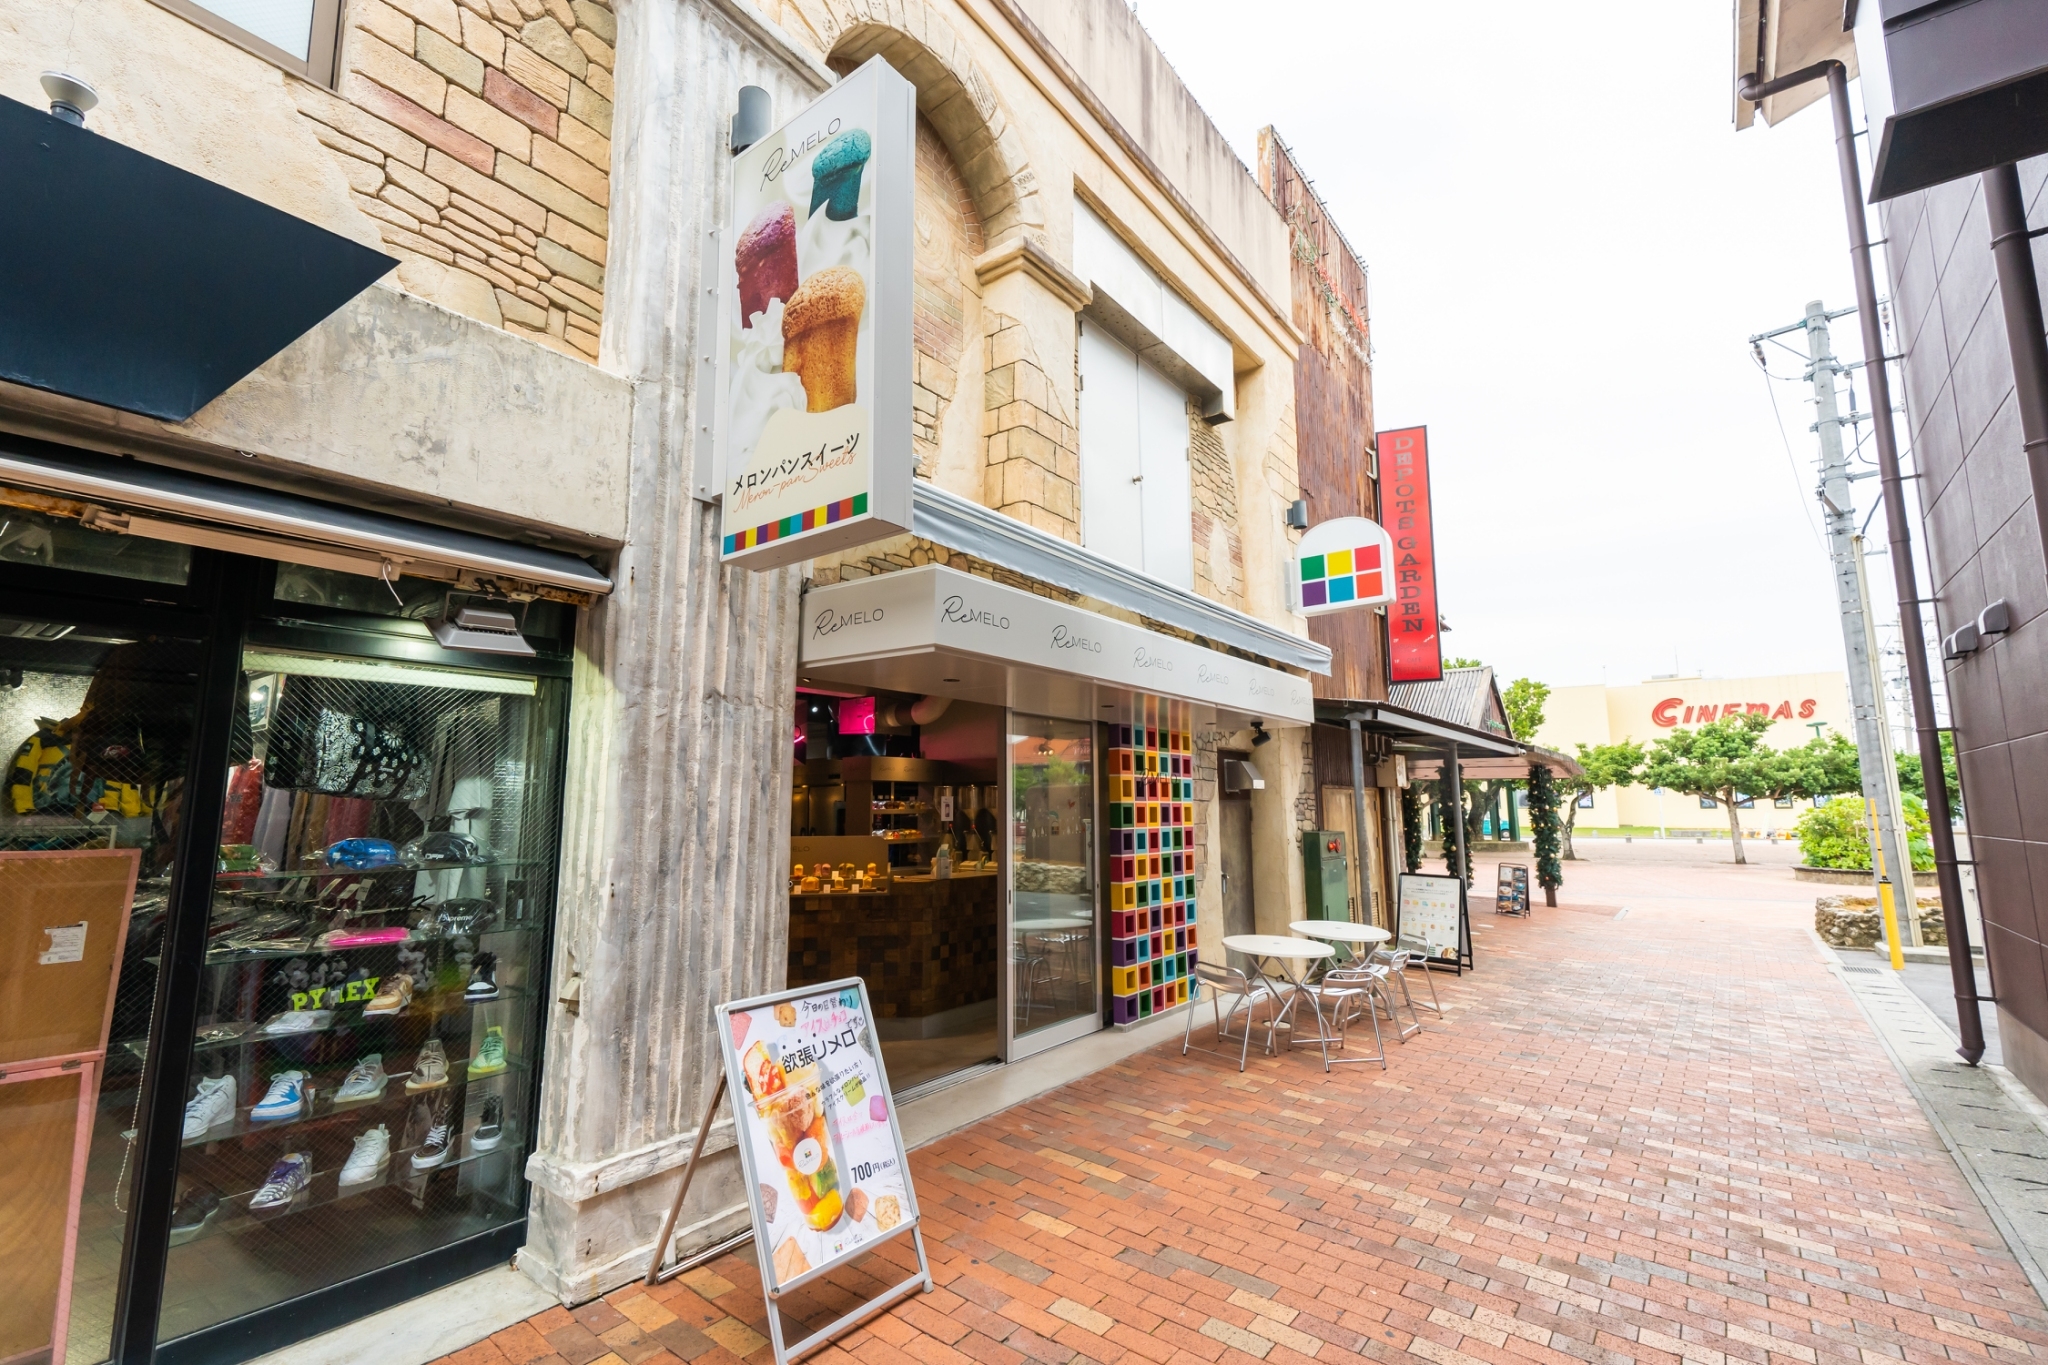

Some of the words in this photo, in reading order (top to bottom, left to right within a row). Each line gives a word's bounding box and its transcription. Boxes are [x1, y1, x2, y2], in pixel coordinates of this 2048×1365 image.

[760, 117, 841, 192] ReMELO
[733, 433, 860, 496] メロンパンスイーツ
[1397, 536, 1425, 632] GARDEN
[813, 608, 884, 640] ReMELO
[941, 595, 1010, 630] ReMELO
[1050, 624, 1102, 653] ReMELO
[1133, 646, 1174, 672] ReMELO
[1651, 697, 1817, 728] CINEMAS
